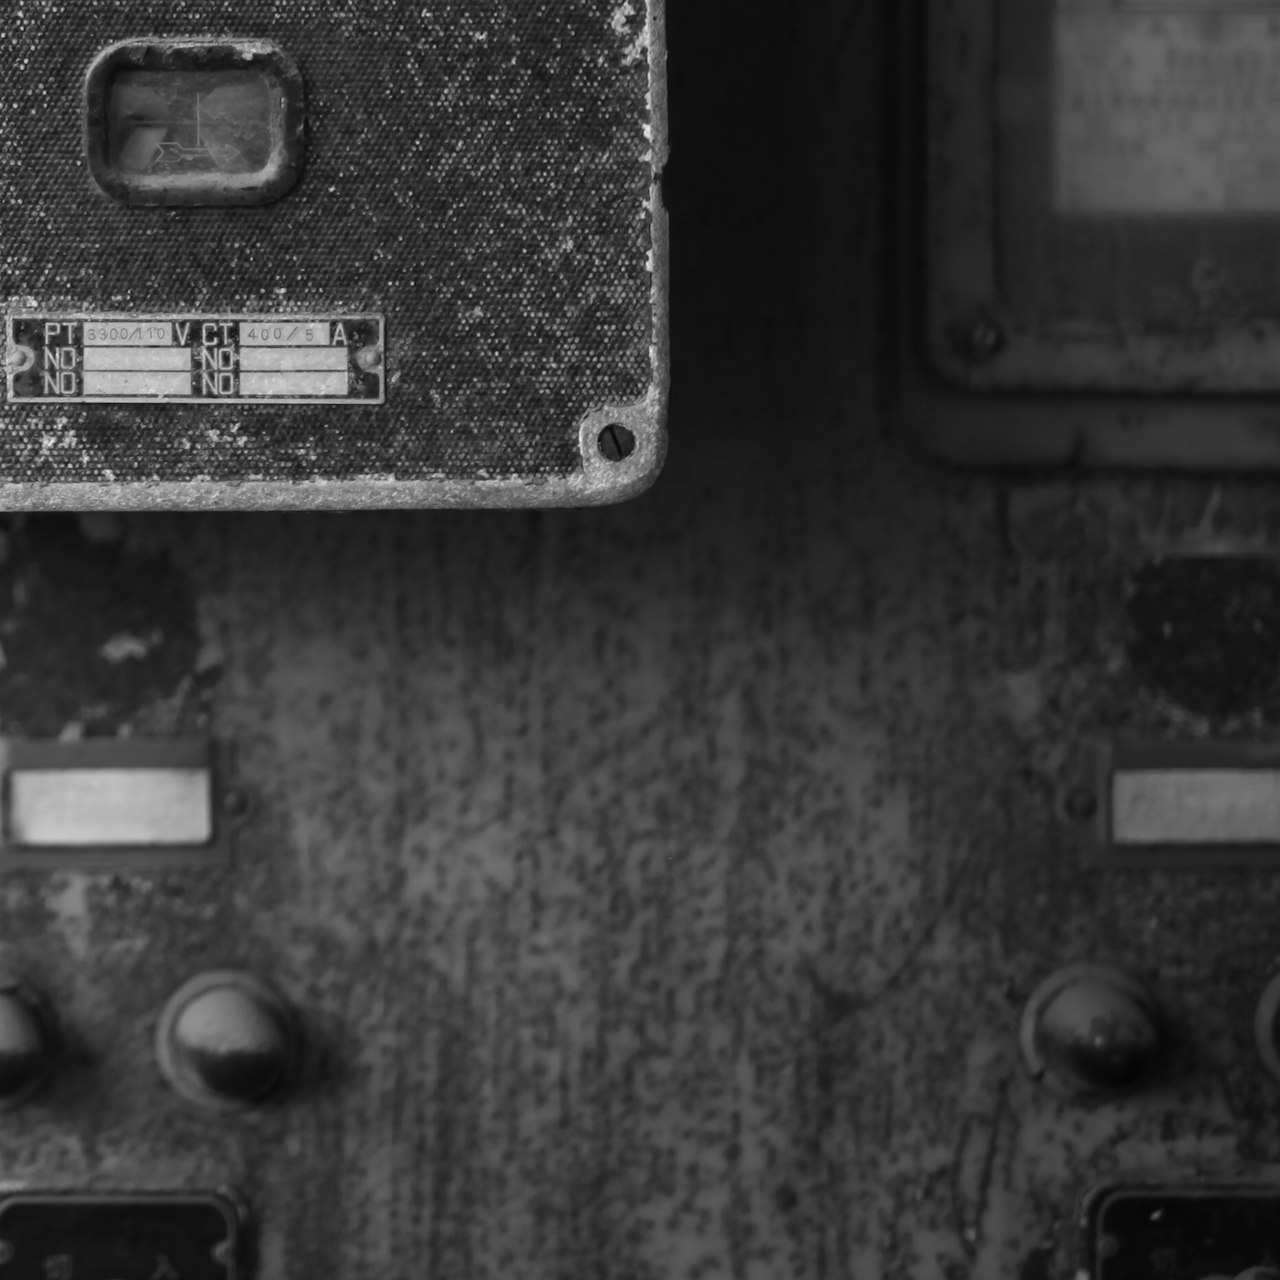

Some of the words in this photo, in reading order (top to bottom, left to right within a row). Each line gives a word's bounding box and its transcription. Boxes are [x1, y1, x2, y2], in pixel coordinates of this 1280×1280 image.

[44, 322, 76, 346] PT
[87, 326, 167, 342] 3300/110
[175, 322, 191, 346] V
[202, 322, 234, 346] CT
[332, 322, 348, 346] A
[44, 347, 76, 370] NO
[202, 347, 235, 370] NO
[44, 372, 76, 395] NO
[202, 372, 235, 395] NO
